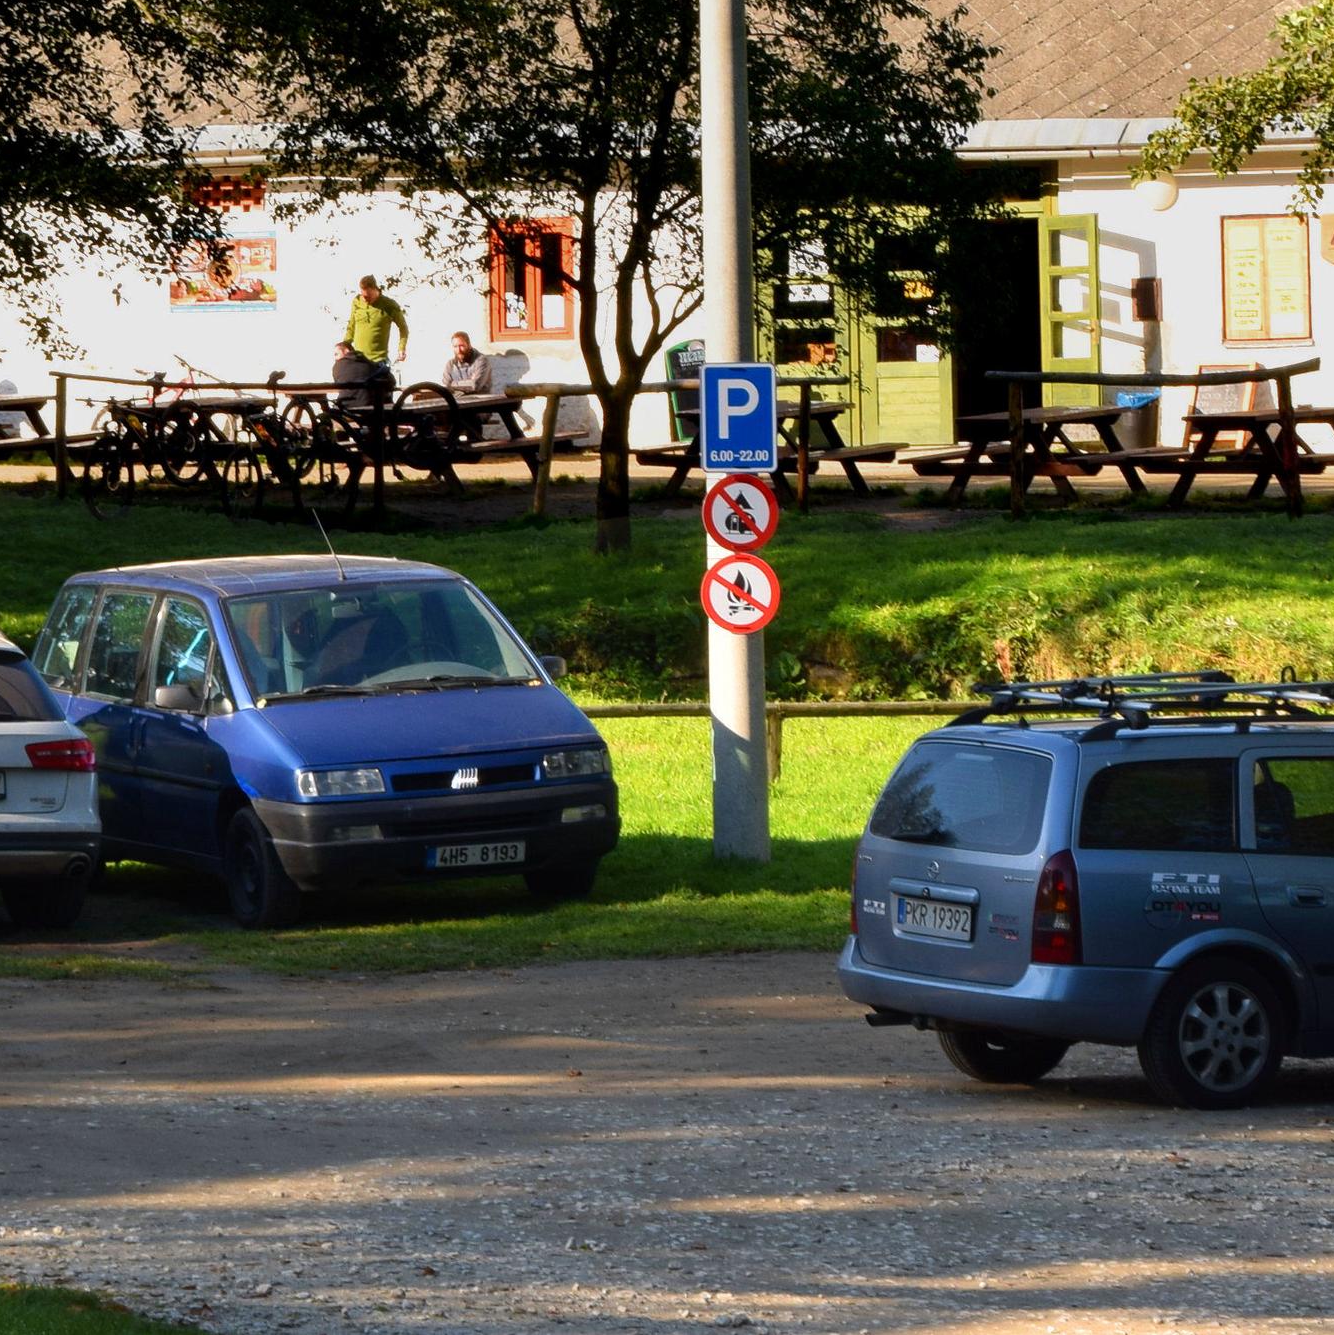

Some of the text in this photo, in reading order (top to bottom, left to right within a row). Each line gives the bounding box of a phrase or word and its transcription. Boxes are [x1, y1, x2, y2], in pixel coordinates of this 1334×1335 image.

[718, 378, 760, 440] P
[710, 450, 769, 463] 6.00-22.00
[440, 845, 519, 865] 4H5 8193
[1193, 886, 1221, 895] TEAM
[905, 901, 929, 928] PKR
[933, 905, 970, 933] 19392
